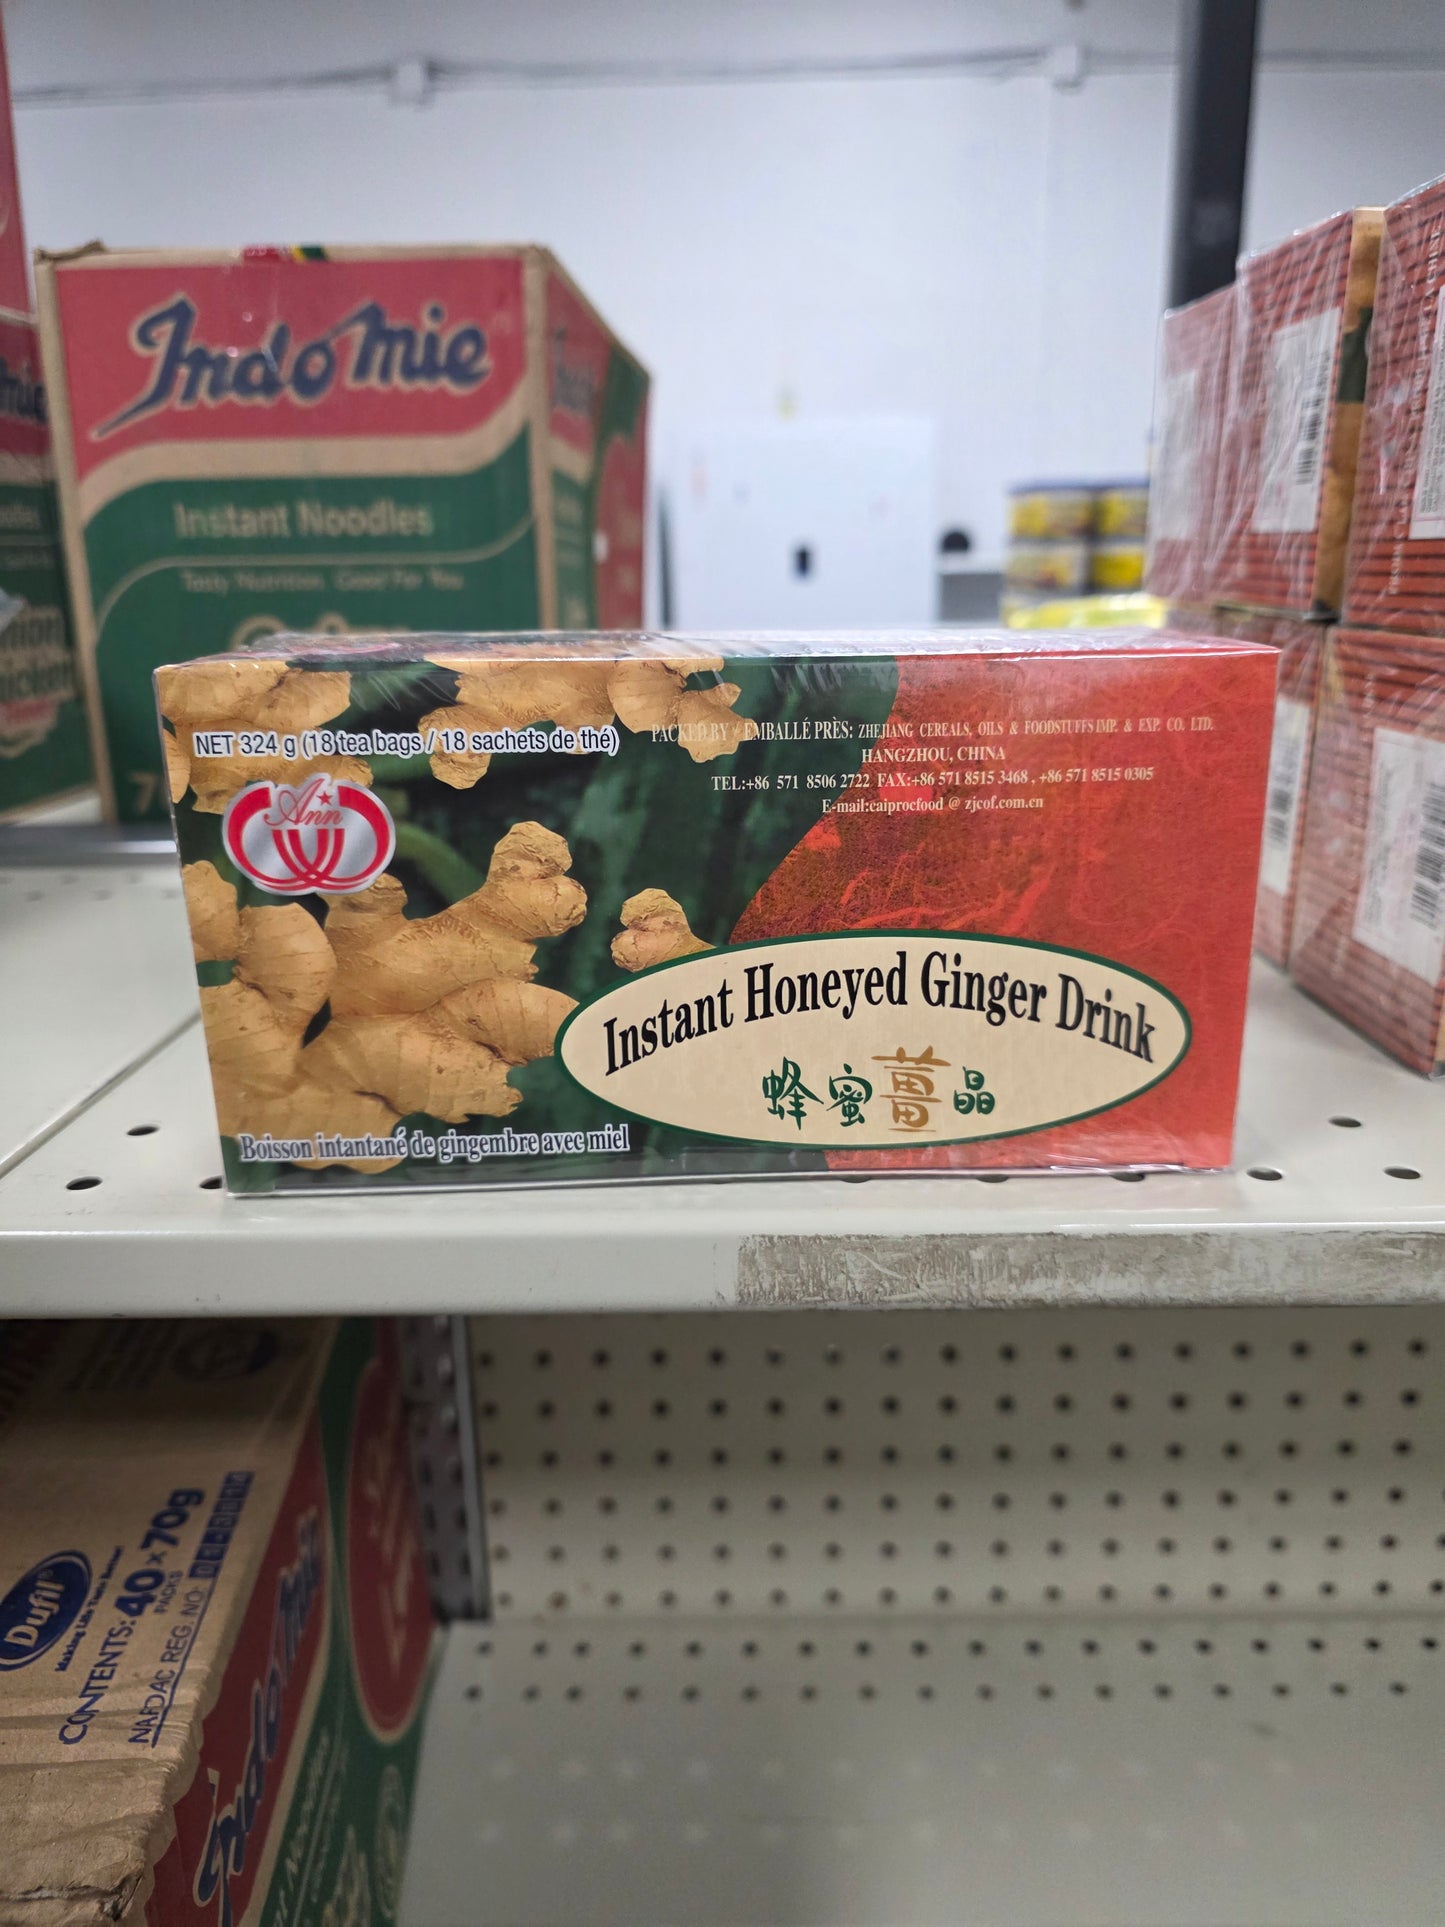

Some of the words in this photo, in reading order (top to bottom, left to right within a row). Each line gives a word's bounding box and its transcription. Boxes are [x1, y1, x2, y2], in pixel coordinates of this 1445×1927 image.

[173, 503, 291, 538] Instant
[297, 498, 435, 537] Noodles
[195, 734, 234, 755] NET
[240, 734, 278, 755] 324
[284, 736, 296, 757] g
[302, 732, 336, 758] (18
[339, 732, 370, 754] tea
[375, 731, 422, 757] bags
[441, 730, 466, 751] 18
[472, 729, 546, 751] sachets
[551, 729, 575, 750] de
[580, 727, 619, 754] thé)
[651, 722, 708, 743] PACKED
[711, 722, 729, 741] BY
[744, 716, 811, 741] EMBALLÉ
[814, 716, 853, 740] PRÈS:
[858, 722, 914, 739] ZHEJIANG
[978, 720, 1004, 736] OILS
[1009, 720, 1019, 735] &
[1024, 718, 1094, 735] FOODSTUFFS
[1123, 718, 1133, 733] &
[1166, 716, 1186, 732] CO.
[1190, 716, 1215, 732] LTD.
[861, 746, 955, 764] HANGZHOU,
[957, 746, 1006, 762] CHINA
[711, 775, 771, 791] TEL:+86
[776, 774, 799, 790] 571
[806, 773, 837, 789] 8506
[840, 773, 871, 788] 2722
[877, 771, 936, 788] FAX:+86
[938, 770, 961, 786] 571
[964, 769, 995, 786] 8515
[997, 769, 1029, 785] 3468
[1039, 768, 1063, 784] +86
[1065, 768, 1088, 783] 571
[1091, 767, 1122, 782] 8515
[1124, 766, 1155, 781] 0305
[263, 777, 344, 828] Ann
[948, 796, 961, 811] @
[603, 977, 735, 1077] Instant
[744, 950, 908, 1021] Honeyed
[920, 951, 1048, 1028] Ginger
[1057, 972, 1157, 1064] Drink
[761, 1044, 997, 1133] 蜂蜜薑晶
[240, 1135, 313, 1161] Boisson
[318, 1127, 408, 1159] intantané
[412, 1131, 435, 1156] de
[439, 1128, 538, 1161] gingembre
[542, 1133, 585, 1153] avec
[587, 1124, 630, 1152] miel
[4, 1579, 66, 1649] Dufil
[58, 1619, 137, 1745] CONTENTS:
[114, 1568, 166, 1617] 40
[140, 1487, 206, 1550] 70g
